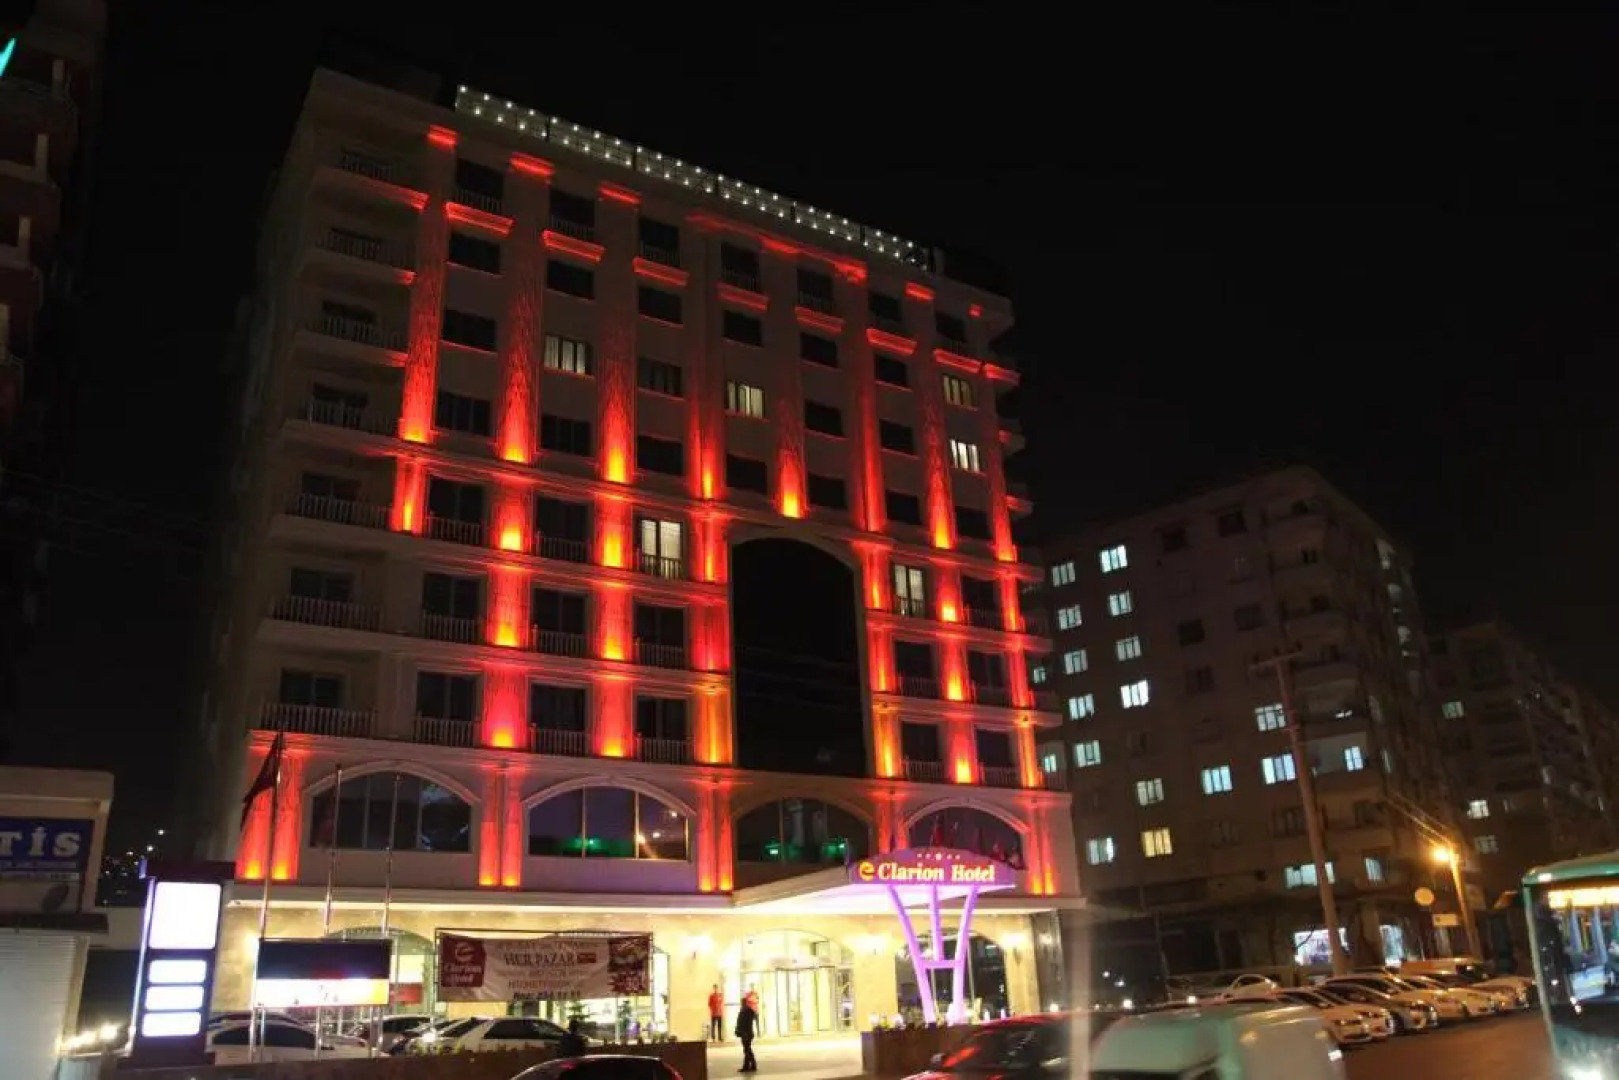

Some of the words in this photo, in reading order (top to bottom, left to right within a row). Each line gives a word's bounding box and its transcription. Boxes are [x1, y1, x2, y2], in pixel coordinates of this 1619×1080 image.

[878, 862, 945, 881] Clarion
[951, 864, 996, 882] Hotel
[535, 952, 575, 967] PAZAR
